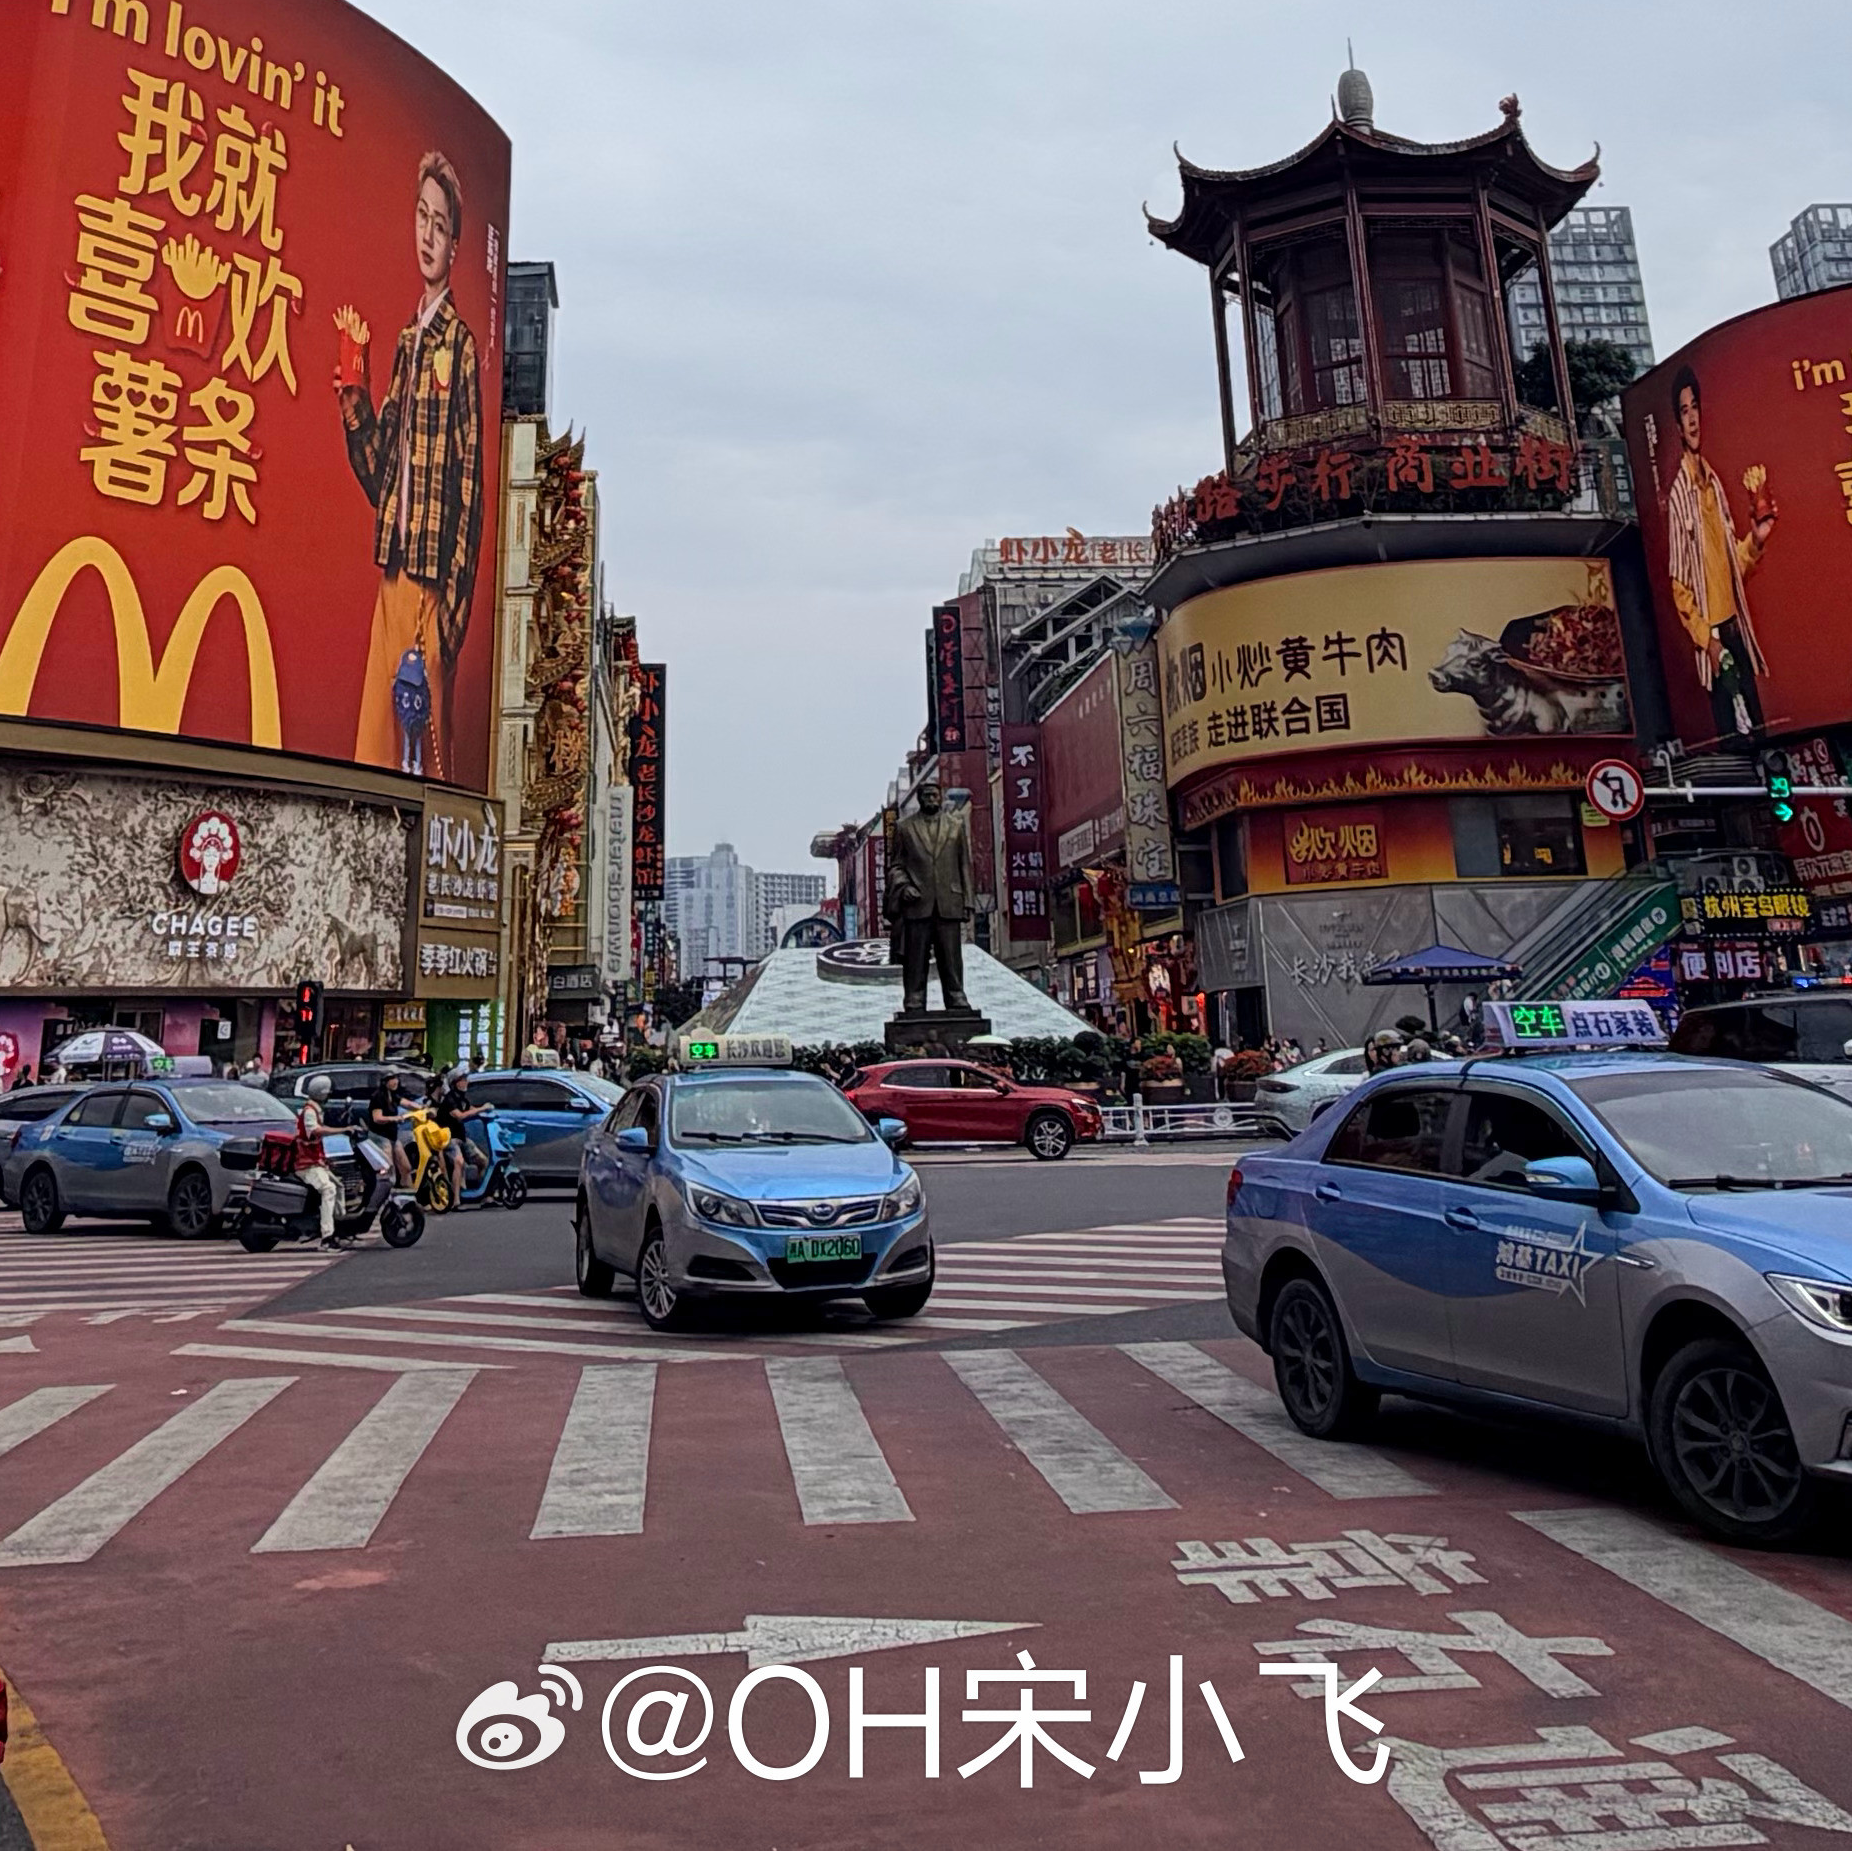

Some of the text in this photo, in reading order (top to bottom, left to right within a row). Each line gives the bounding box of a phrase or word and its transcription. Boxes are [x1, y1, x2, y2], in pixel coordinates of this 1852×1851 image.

[312, 69, 346, 139] it
[117, 66, 288, 253] 我就
[66, 191, 304, 400] 喜欢
[79, 349, 258, 526] 薯条
[999, 526, 1089, 566] 虾小龙
[1206, 692, 1351, 749] 走进联合国
[1124, 658, 1169, 880] 周六福珠宝
[427, 802, 499, 876] 虾小龙
[152, 912, 257, 938] CHAGEE
[420, 943, 488, 978] 季季红火锅
[1571, 1008, 1657, 1038] 点石家装
